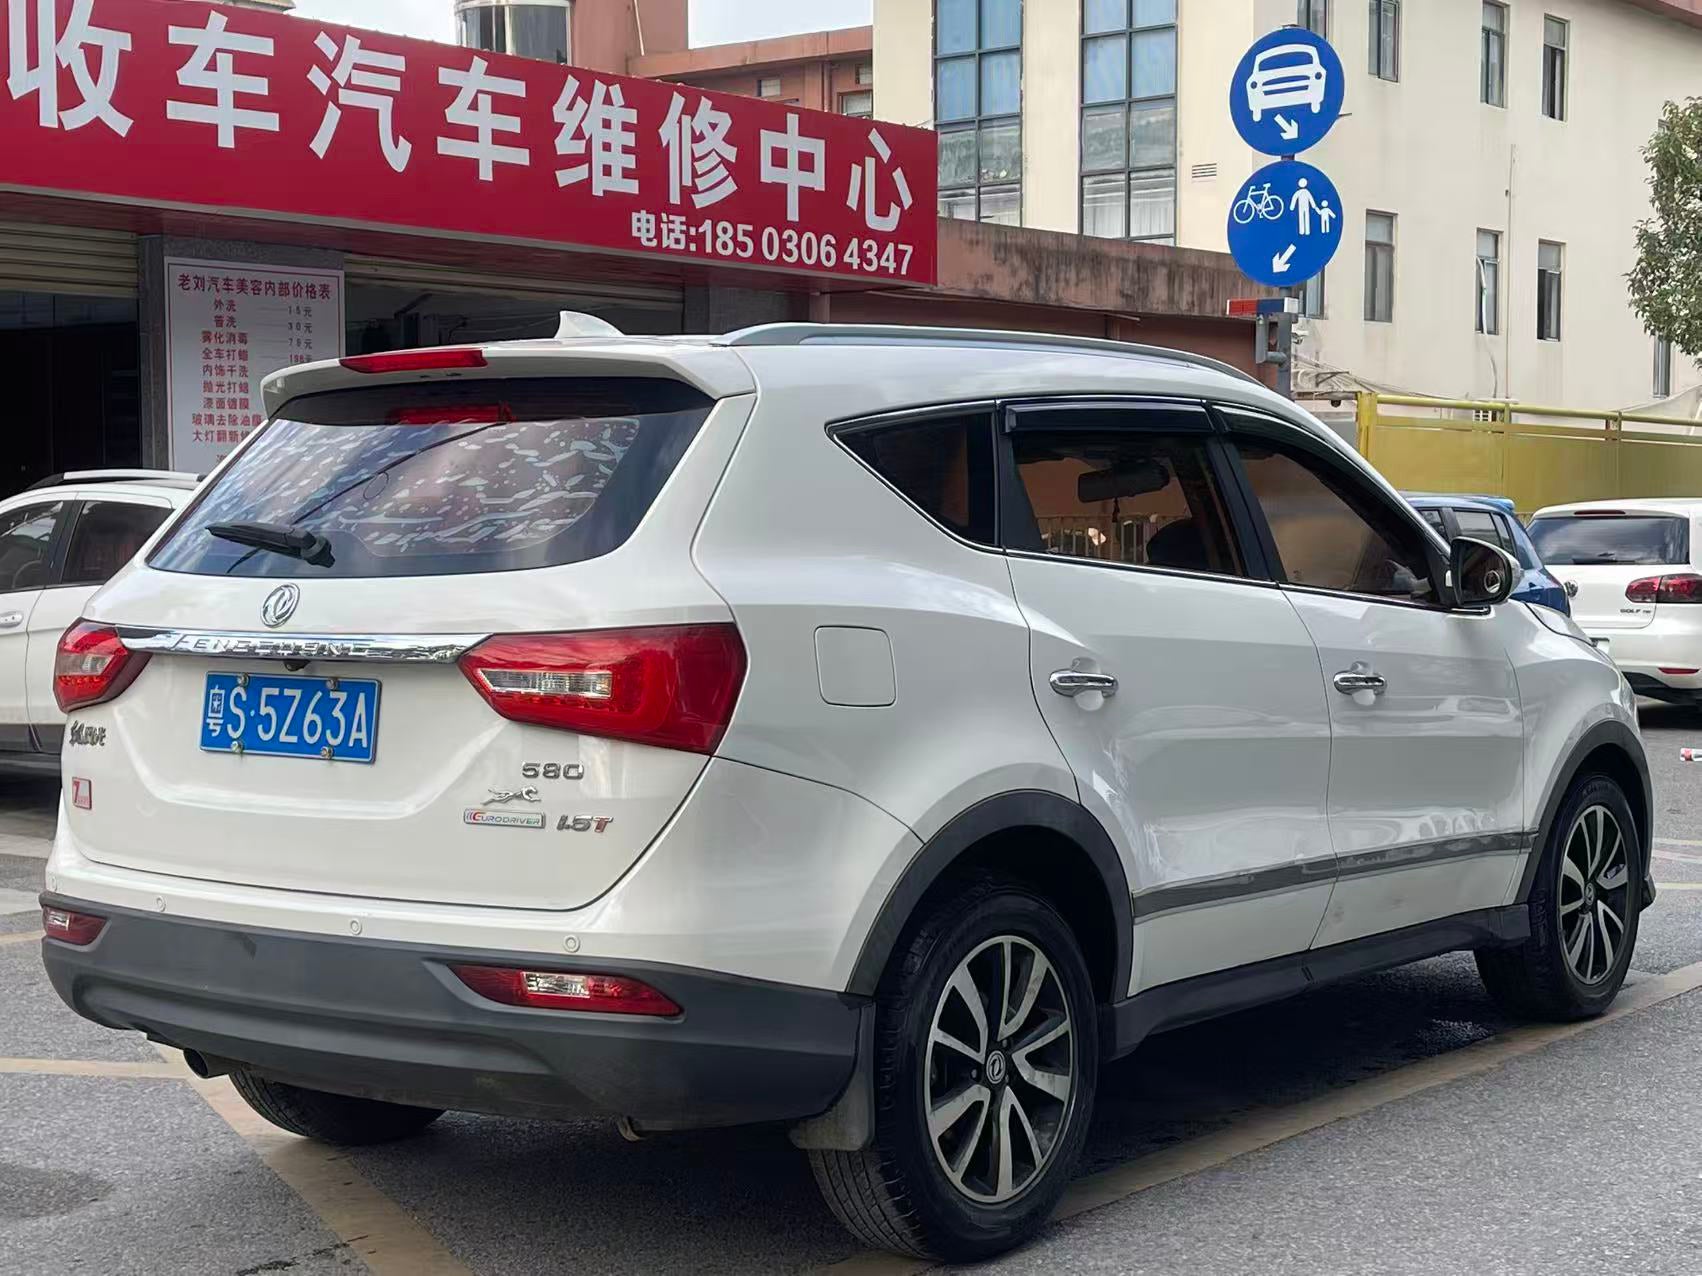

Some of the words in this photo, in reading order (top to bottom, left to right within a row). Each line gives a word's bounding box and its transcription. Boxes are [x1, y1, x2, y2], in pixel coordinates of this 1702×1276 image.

[7, 0, 913, 232] 收车汽车维修中心
[761, 226, 836, 267] 0306
[843, 236, 914, 275] 4347
[178, 273, 331, 300] 老刘汽车美容内部价格表
[213, 299, 237, 313] 外洗
[288, 322, 312, 334] 30元
[202, 348, 248, 363] 全车打蜡
[202, 364, 249, 379] 内饰干洗
[522, 762, 584, 780] 580
[472, 811, 541, 825] EURODRIVER
[556, 815, 614, 833] 1.5T
